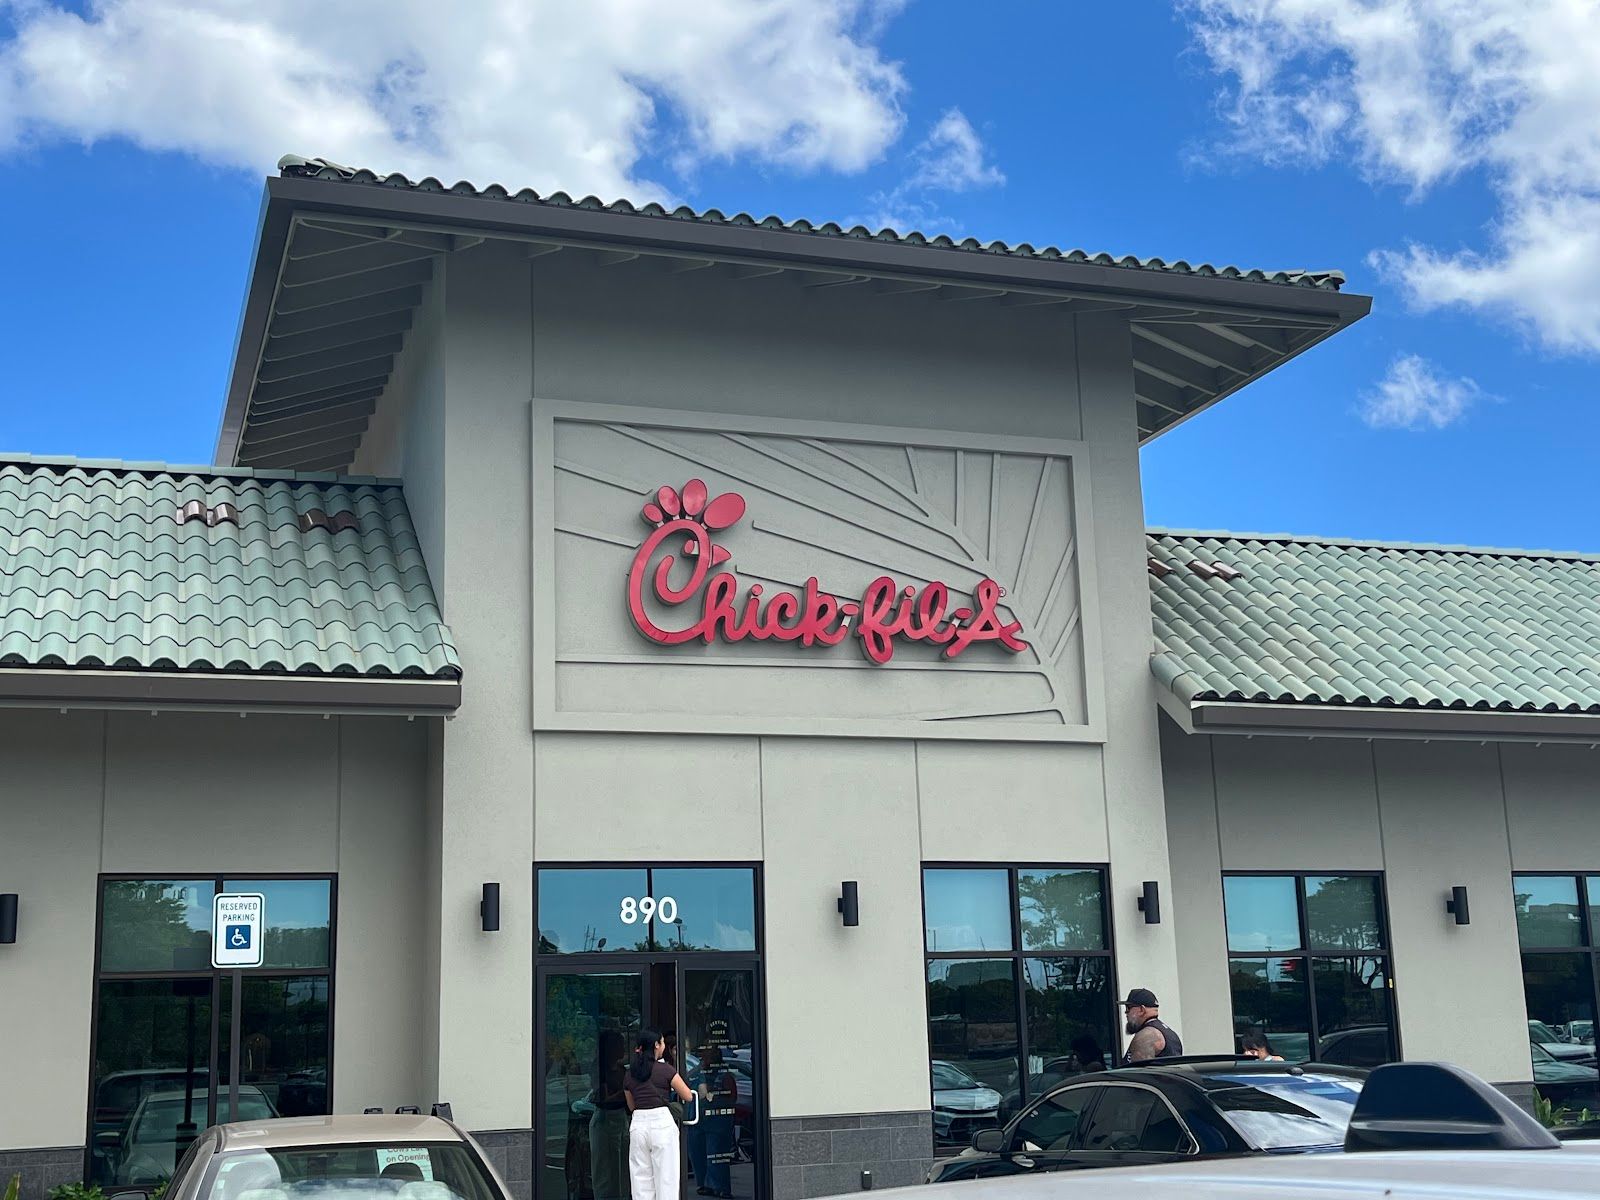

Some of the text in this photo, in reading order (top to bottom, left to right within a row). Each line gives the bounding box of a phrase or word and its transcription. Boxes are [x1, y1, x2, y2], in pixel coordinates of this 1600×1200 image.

[627, 517, 1027, 666] Chick-fil-A
[220, 902, 258, 911] RESERVED
[620, 896, 678, 924] 890
[223, 913, 255, 922] PARKING
